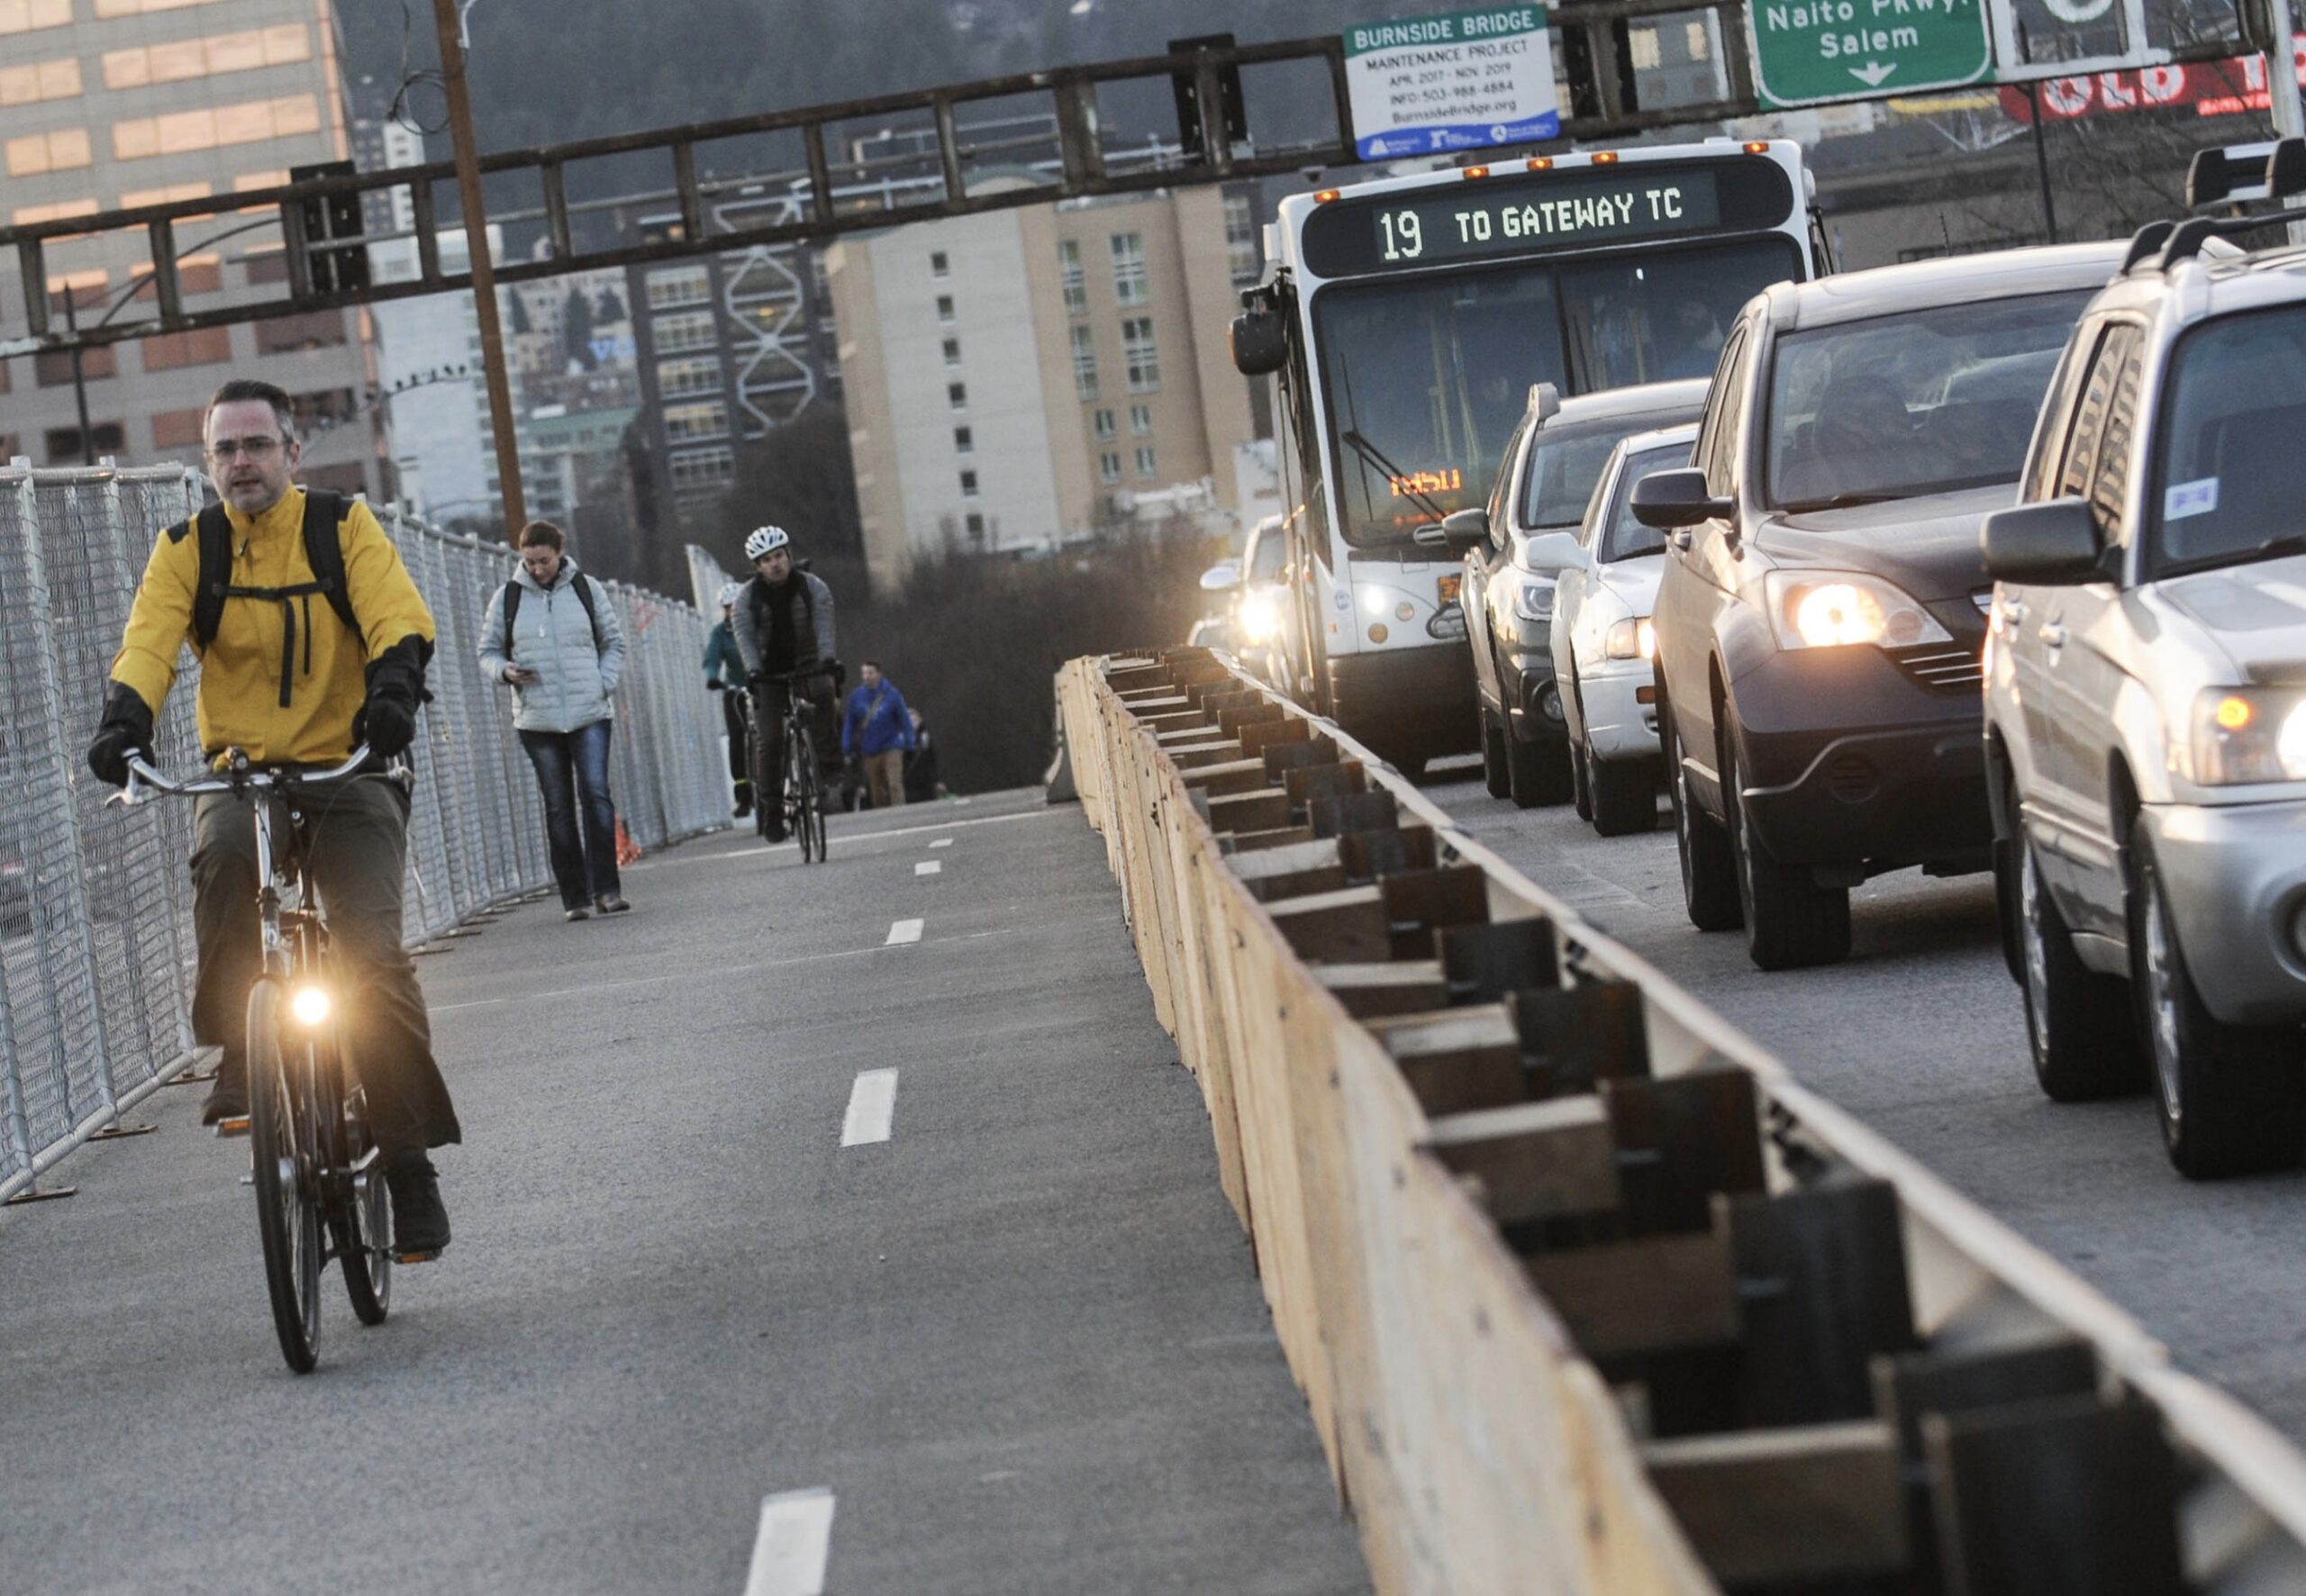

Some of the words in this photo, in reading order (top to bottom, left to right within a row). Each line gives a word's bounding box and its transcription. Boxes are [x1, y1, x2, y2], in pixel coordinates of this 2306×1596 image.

[1354, 20, 1453, 49] BURNSIDE
[1463, 10, 1534, 36] BRIDGE
[1767, 0, 1855, 32] Naito
[1366, 48, 1462, 71] MAINTENANCE
[1468, 40, 1528, 59] PROJECT
[1820, 26, 1919, 59] Salem
[1419, 69, 1444, 84] 2017
[1456, 67, 1479, 79] NOV
[1485, 62, 1512, 76] 2019
[2044, 64, 2184, 115] OLD
[1392, 100, 1517, 124] BurnsideBridge.org
[1380, 210, 1423, 260] 19
[1455, 210, 1492, 243] TO
[1502, 193, 1634, 237] GATEWAY
[1646, 187, 1683, 221] TC
